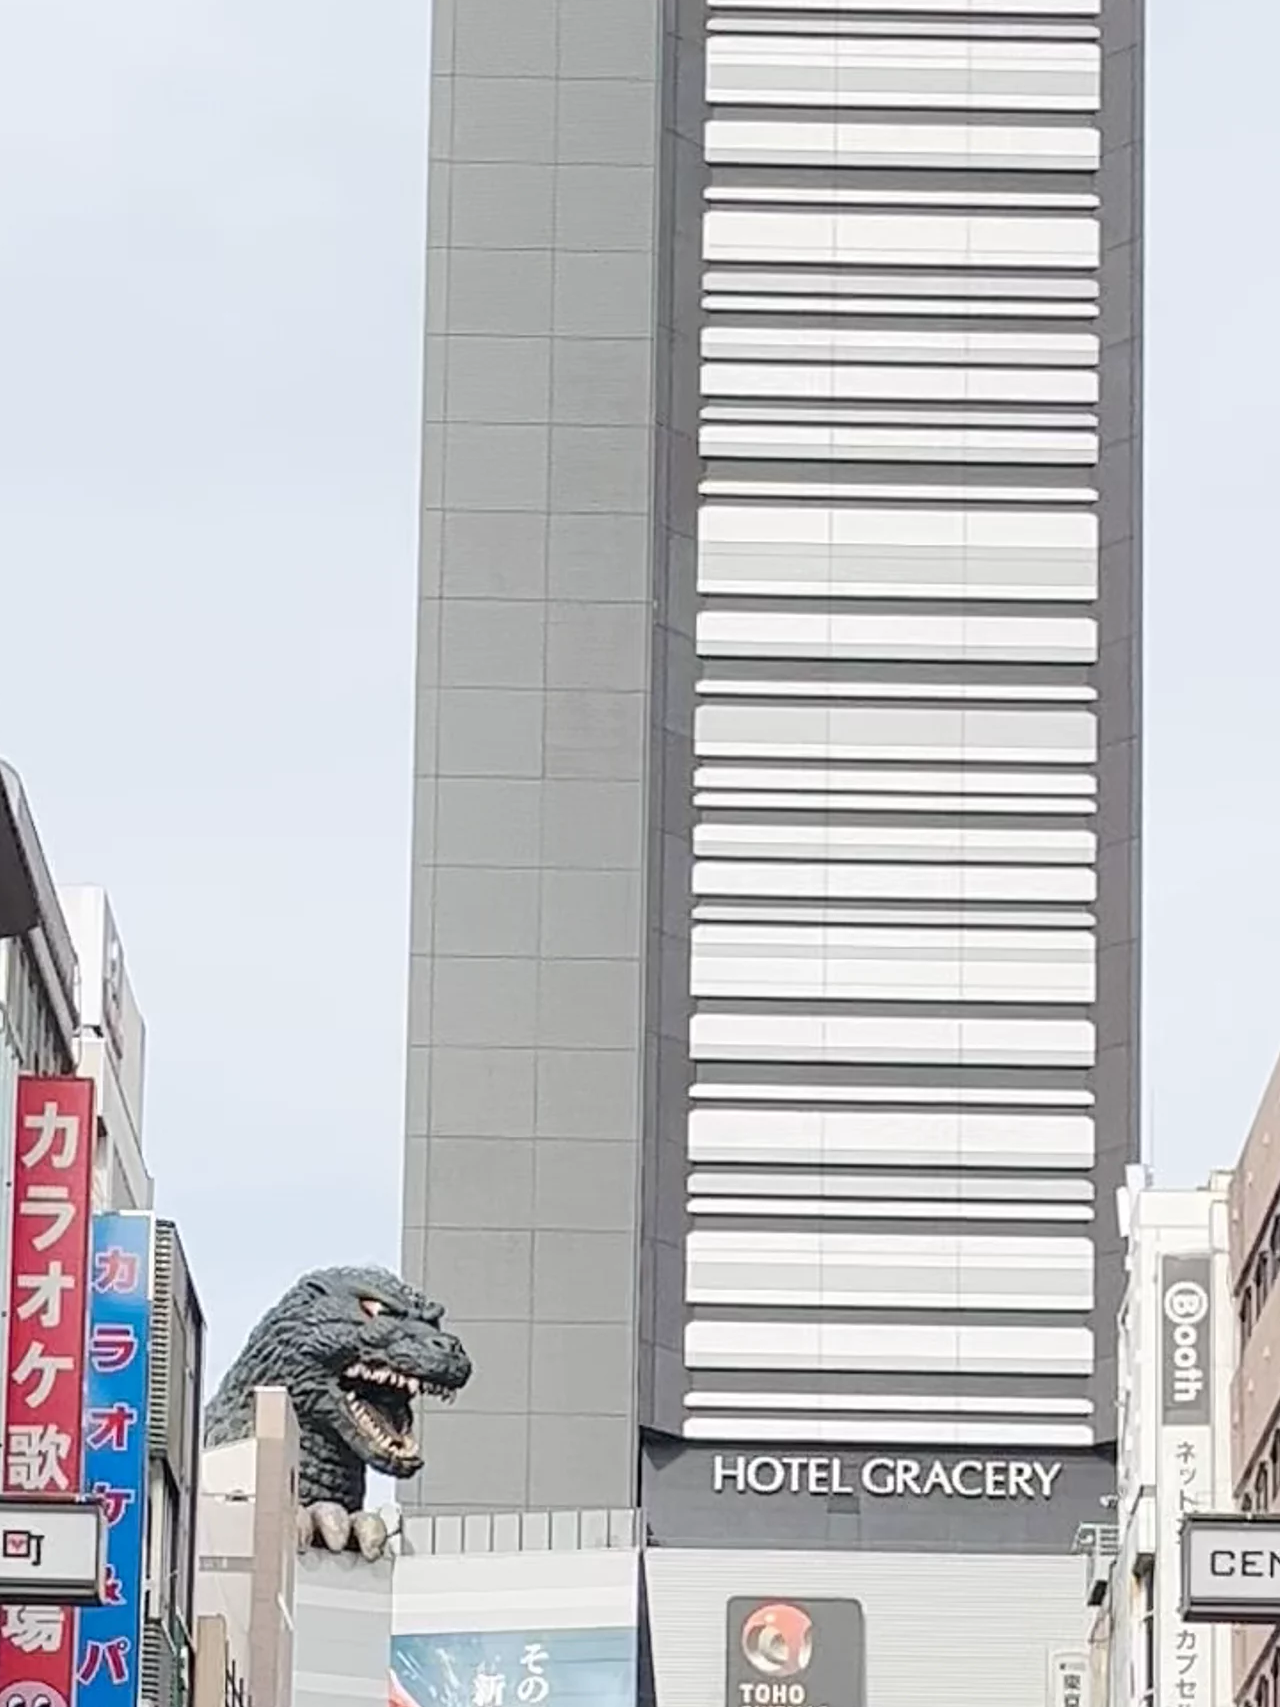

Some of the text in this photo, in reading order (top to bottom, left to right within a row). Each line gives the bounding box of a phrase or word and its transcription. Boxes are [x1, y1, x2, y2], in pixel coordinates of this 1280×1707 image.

[0, 1102, 82, 1653] カラオケ歌場
[1164, 1280, 1209, 1402] Booth
[713, 1454, 1062, 1497] HOTEL GRACERY
[738, 1683, 805, 1704] TOHO
